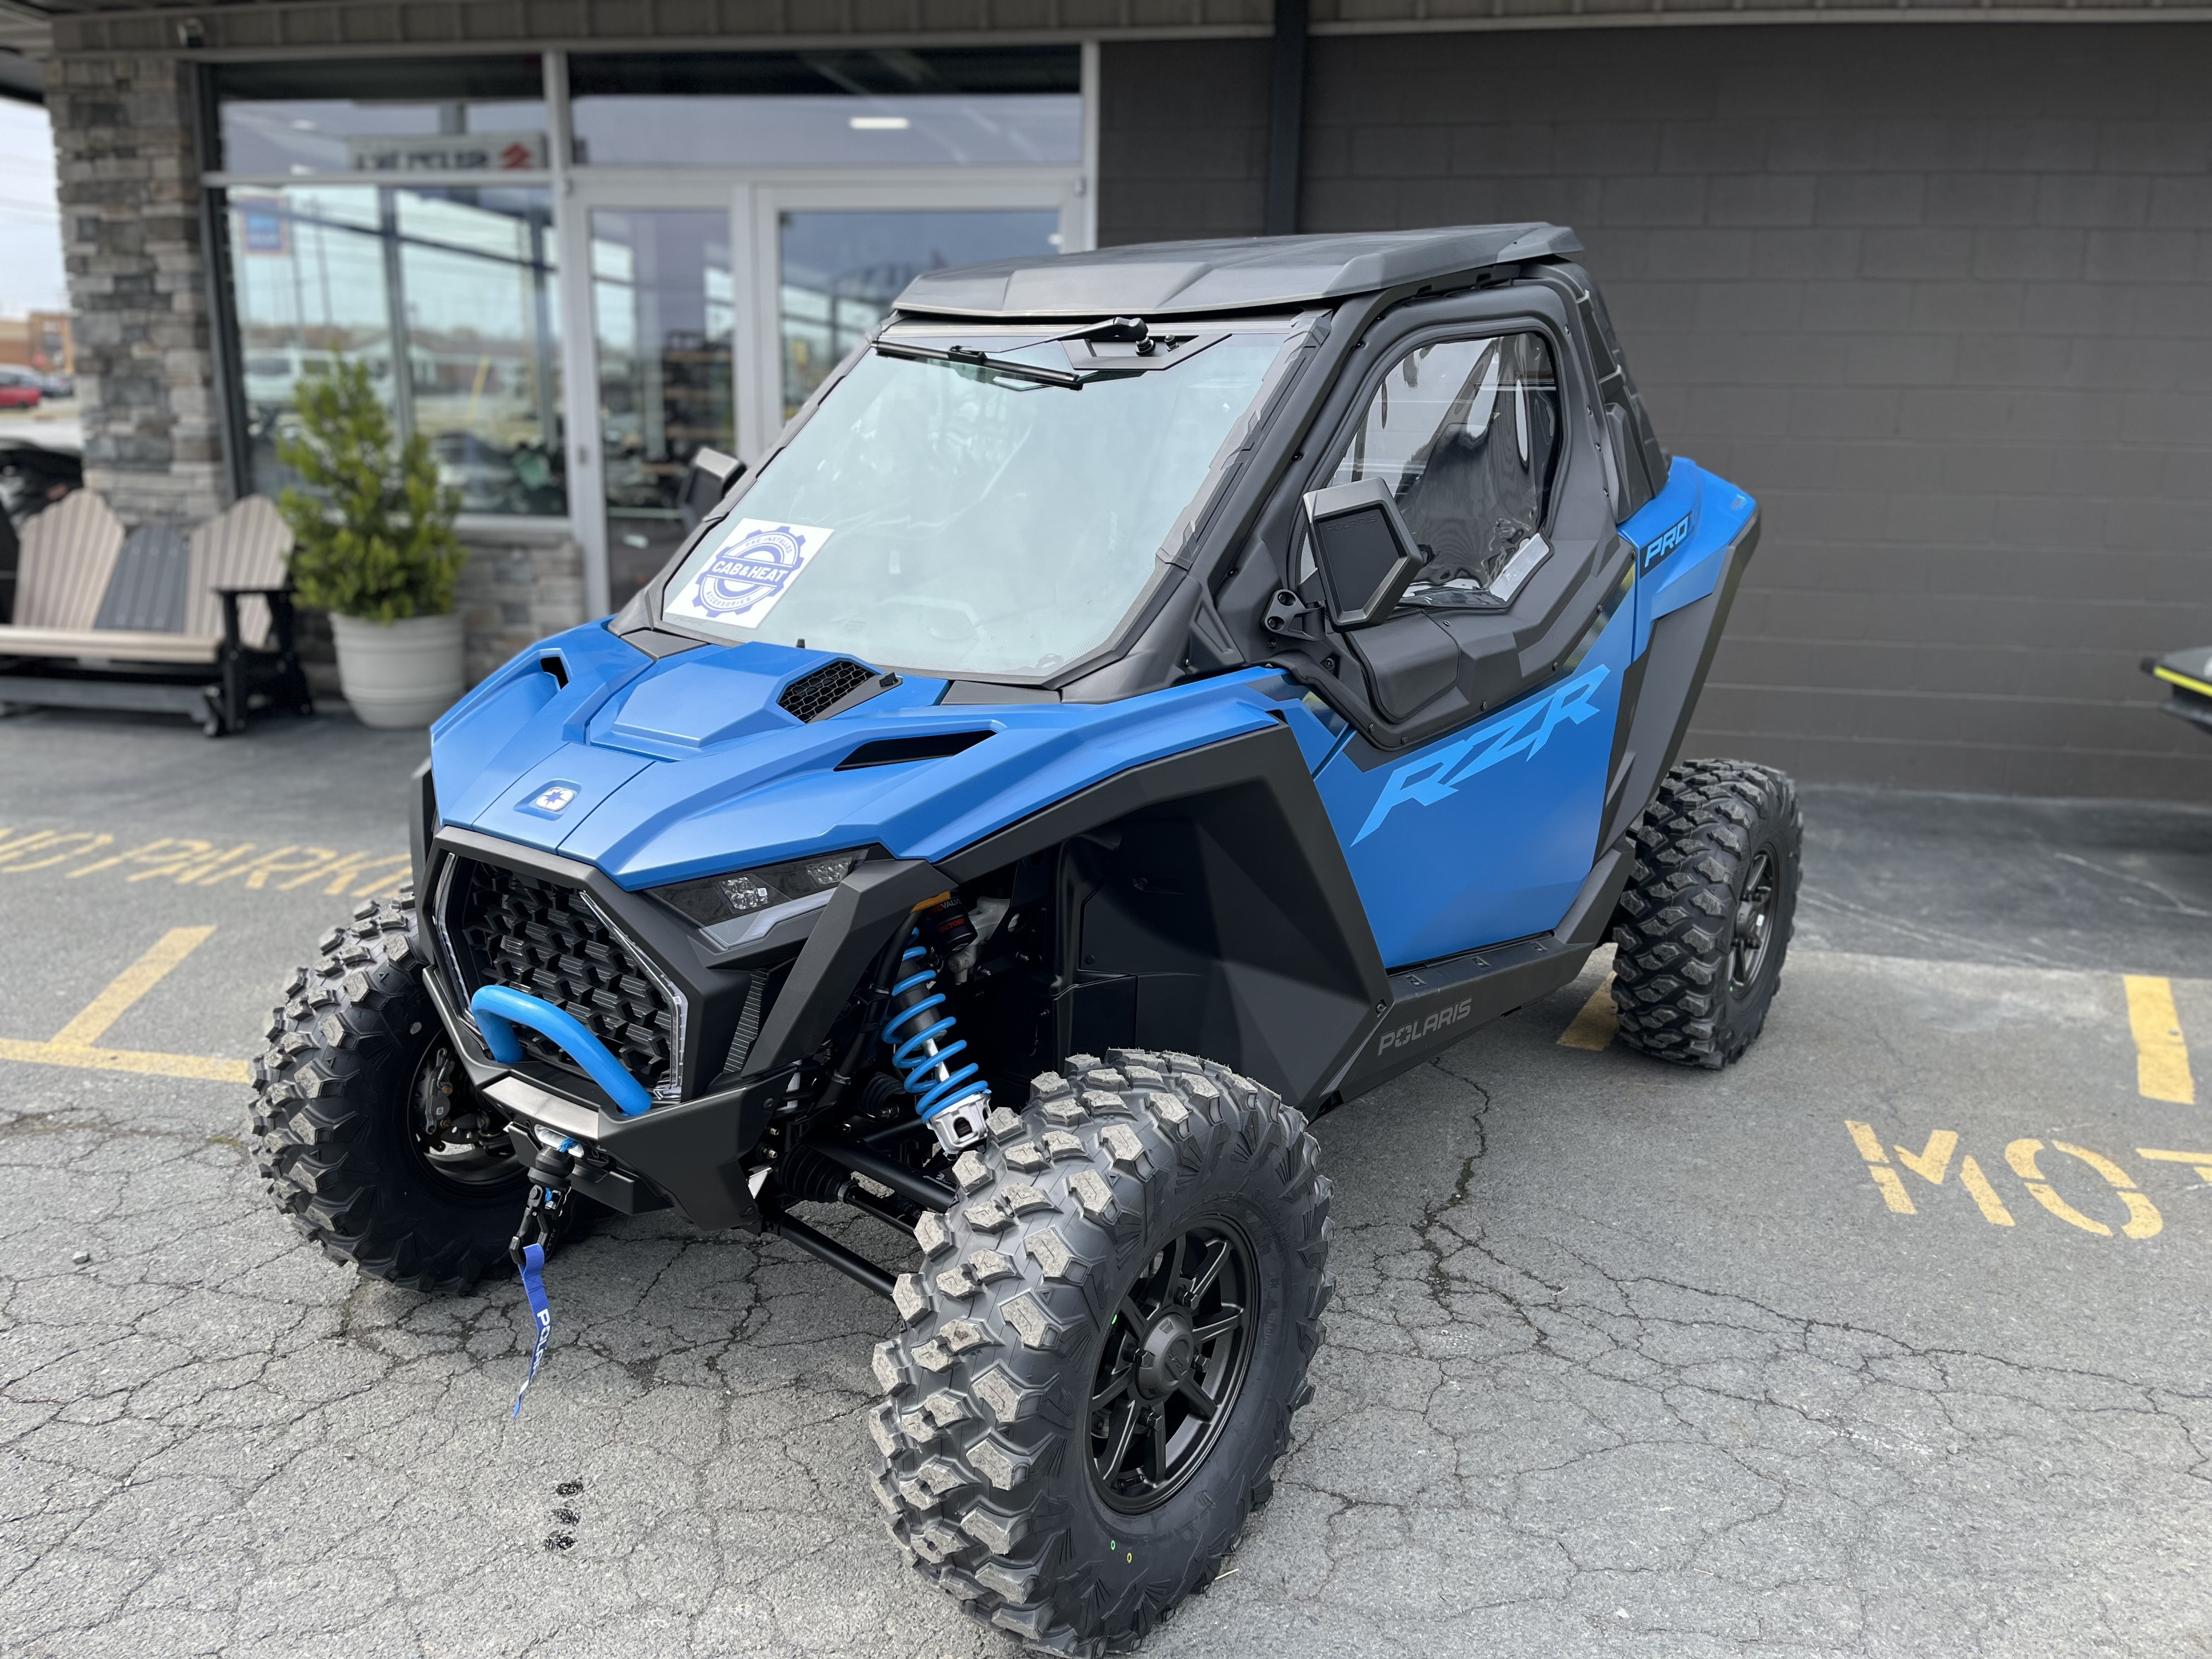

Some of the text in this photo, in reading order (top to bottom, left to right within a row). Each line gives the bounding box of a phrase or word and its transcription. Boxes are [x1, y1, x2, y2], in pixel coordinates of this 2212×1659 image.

[1325, 515, 1378, 533] POLARIS
[746, 537, 792, 554] PRE-INSTALLED
[1645, 516, 1689, 568] PRO
[712, 560, 789, 583] CAB&HEAT
[706, 590, 751, 607] ACCESSORIES
[1350, 663, 1611, 848] RZR
[1377, 997, 1472, 1057] POLARIS
